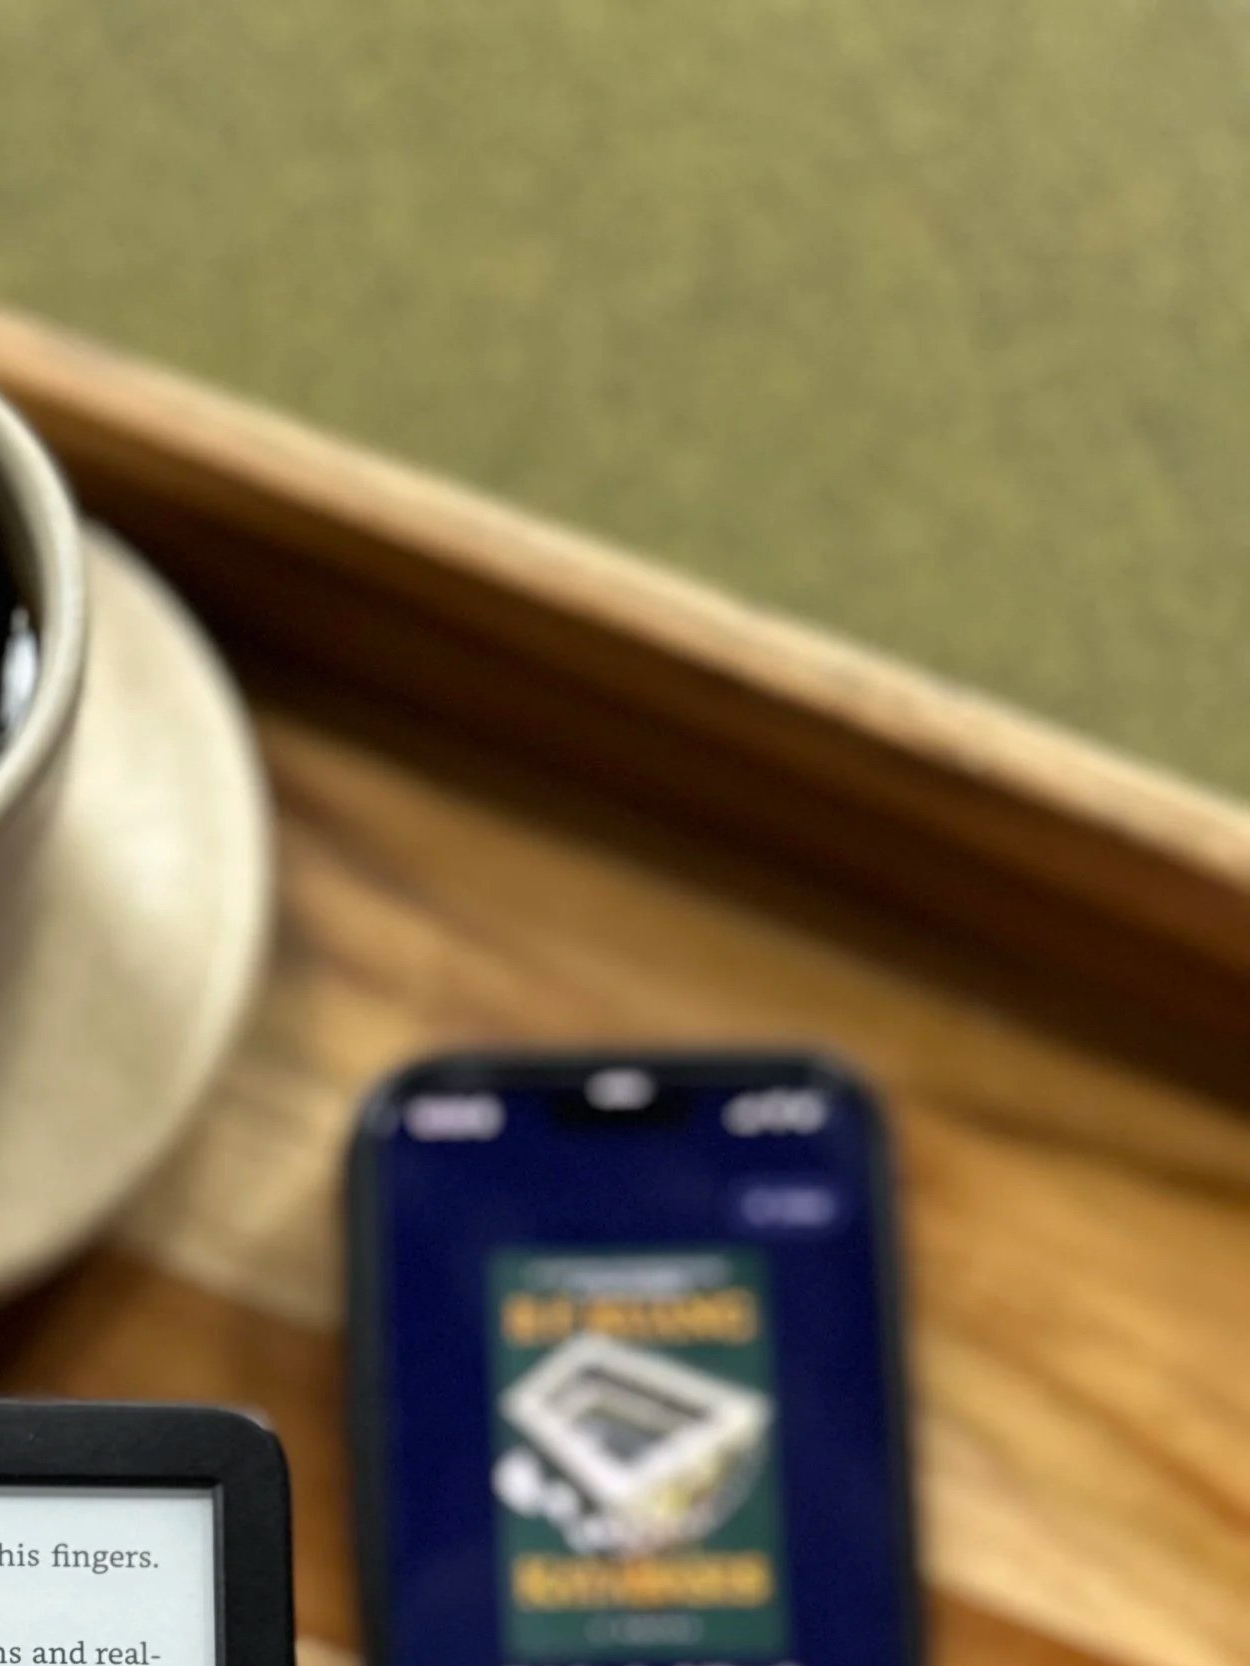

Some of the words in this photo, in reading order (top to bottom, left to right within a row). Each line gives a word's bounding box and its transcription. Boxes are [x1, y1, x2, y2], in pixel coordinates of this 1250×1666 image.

[51, 1542, 159, 1575] fingers.
[31, 1640, 88, 1666] and
[95, 1640, 161, 1666] real-
